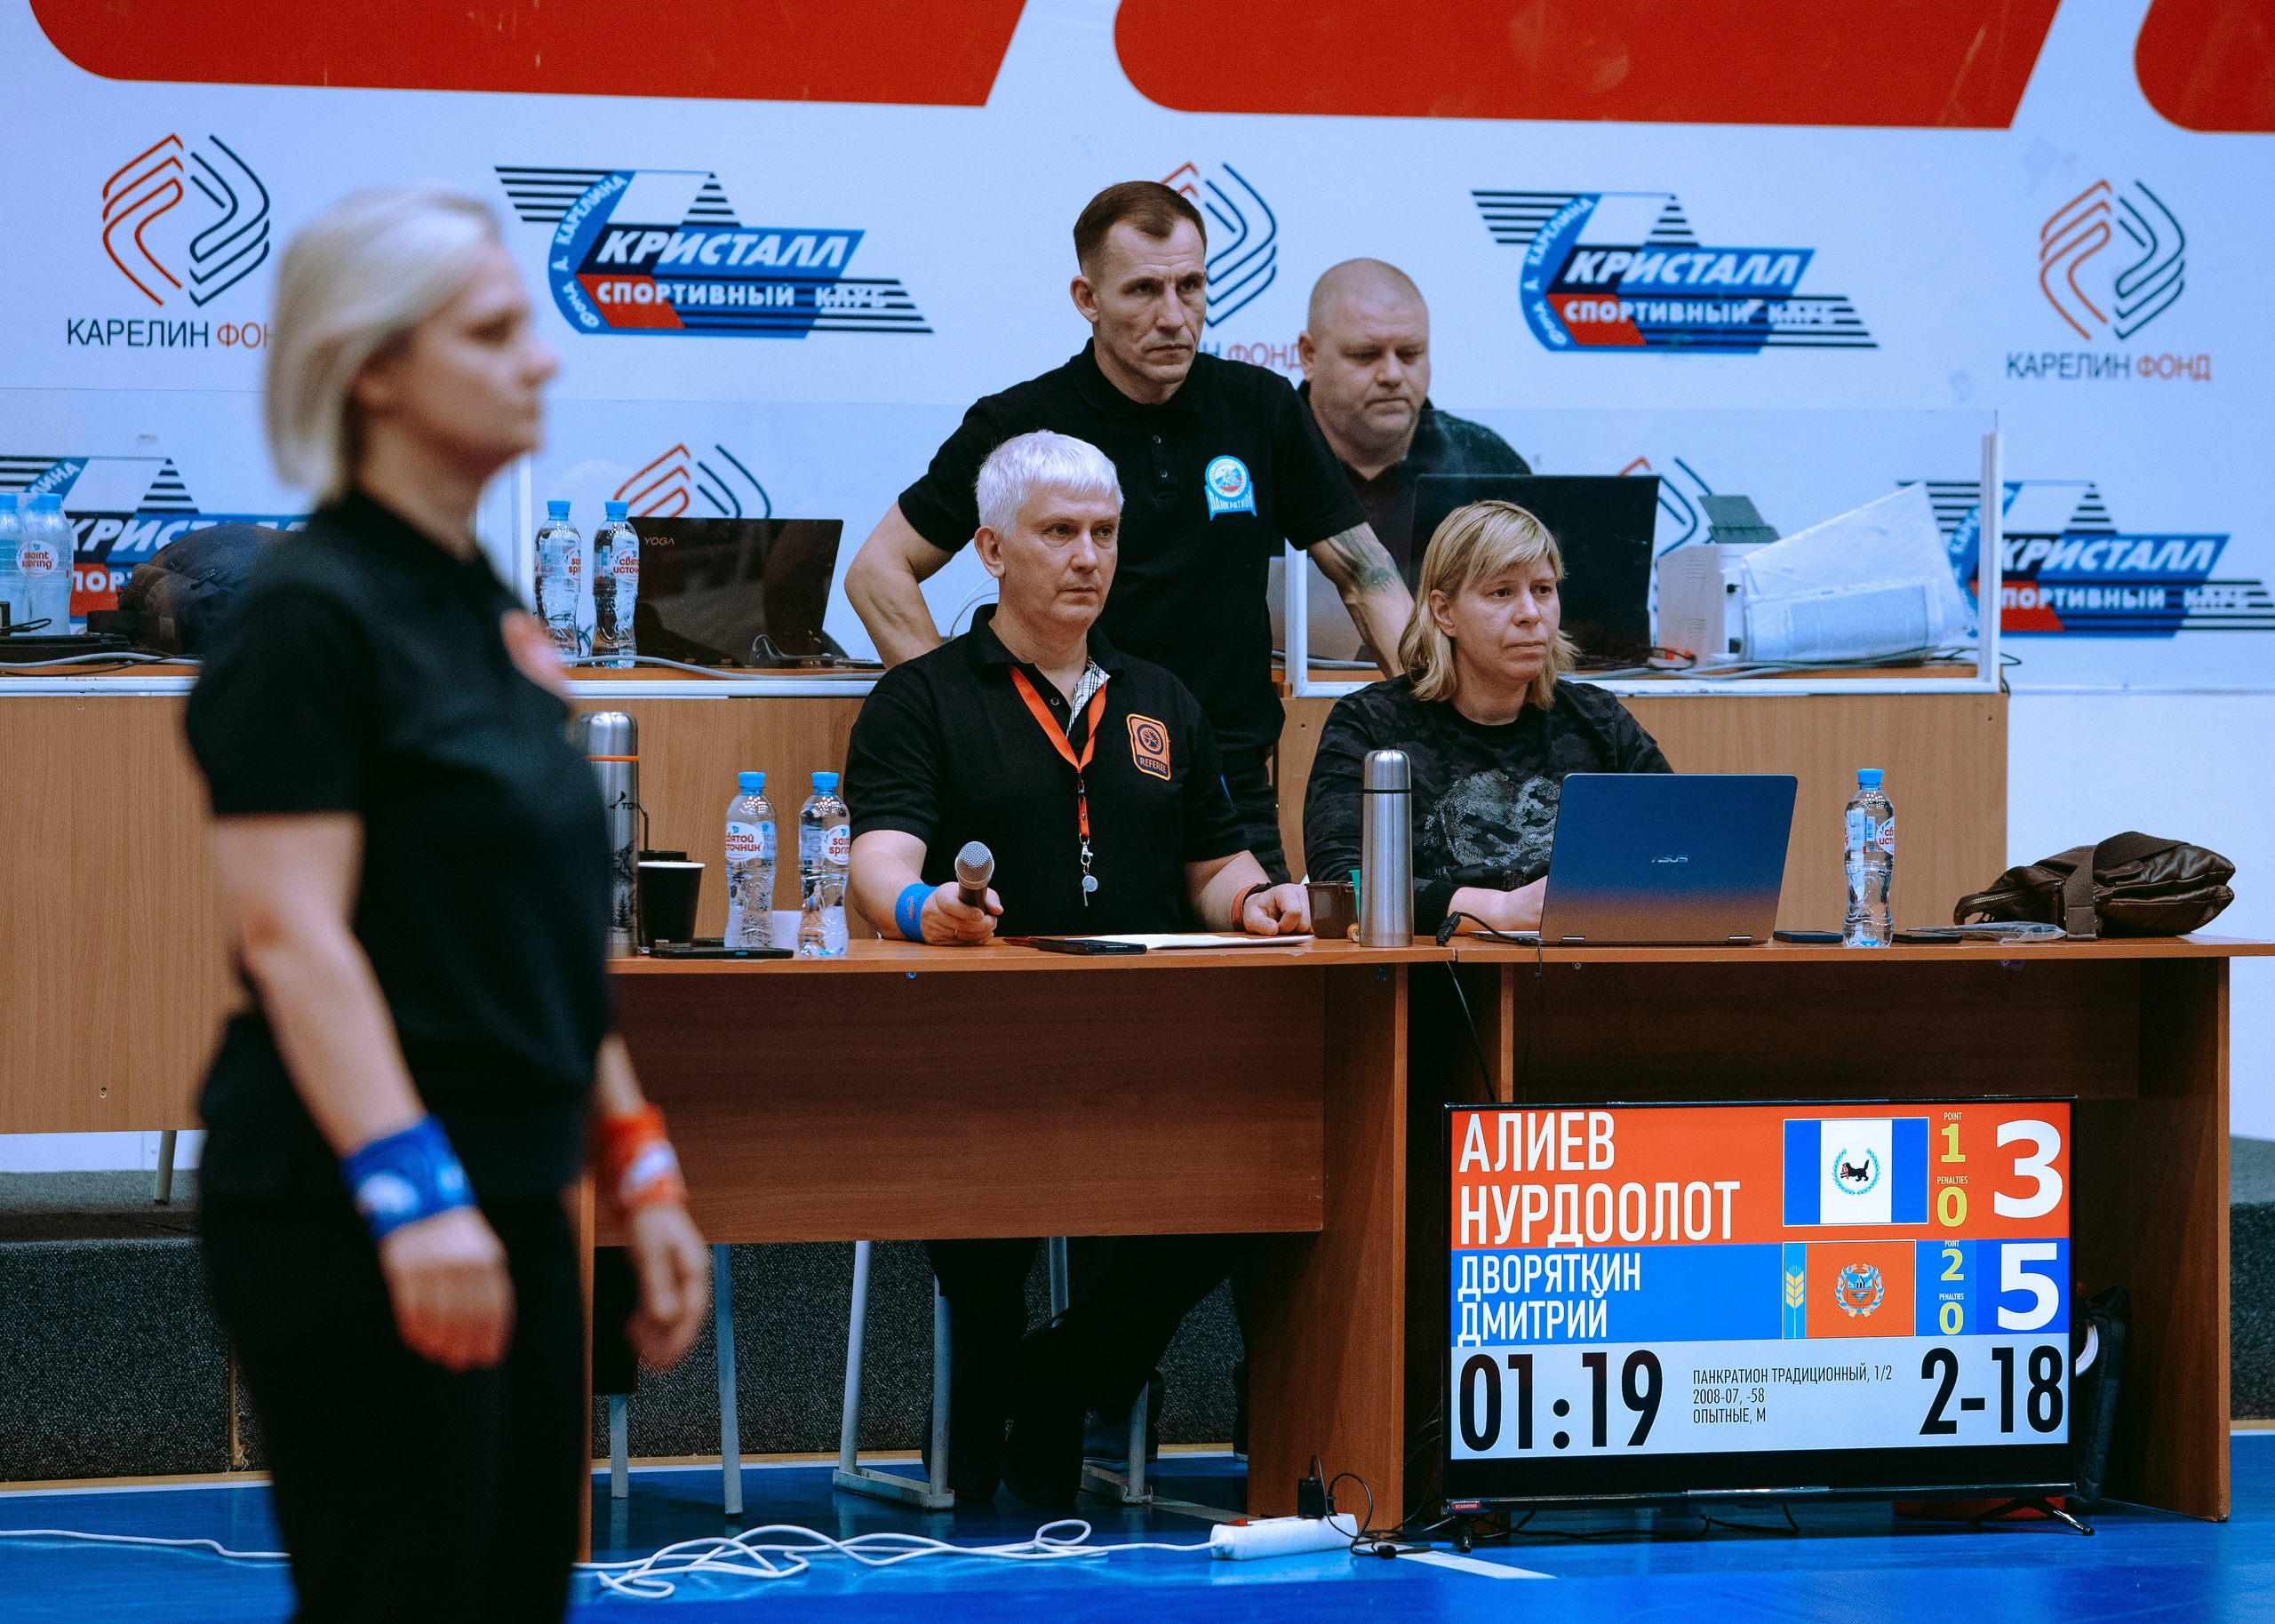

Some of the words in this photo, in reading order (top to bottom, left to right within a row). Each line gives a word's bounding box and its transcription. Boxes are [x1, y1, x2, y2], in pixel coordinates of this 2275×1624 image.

[555, 174, 629, 245] КАРЕЛИНА
[595, 230, 849, 267] КРИСТАЛЛ
[1563, 250, 1801, 285] КРИСТАЛЛ
[597, 282, 795, 307] СПОРТИВНЫЙ
[815, 283, 889, 308] КЛУБ
[1563, 300, 1752, 323] СПОРТИВНЫЙ
[68, 319, 210, 348] КАРЕЛИН
[2006, 352, 2131, 380] КАРЕЛИН
[2136, 354, 2212, 382] ФОНД
[1207, 485, 1253, 512] ПАНКРАТИОН
[644, 537, 675, 546] YOGA
[2000, 538, 2217, 571] КРИСТАЛЛ
[2001, 586, 2167, 609] ПОРТИВНЫЙ
[1139, 757, 1167, 773] REFEREE
[1944, 1112, 1962, 1121] POINT
[1458, 1111, 1615, 1173] АЛИЕВ
[1941, 1123, 1966, 1163] 1
[1936, 1175, 1968, 1185] PENALTIES
[1993, 1119, 2063, 1219] 3
[1461, 1181, 1741, 1248] НУРДООЛОТ
[1936, 1186, 1968, 1228] 0
[1457, 1253, 1640, 1302] ДВОРЯТКИН
[1941, 1248, 1964, 1281] 2
[1998, 1242, 2059, 1331] 5
[1457, 1289, 1608, 1348] ДМИТРИЙ
[1939, 1302, 1964, 1335] 0
[1693, 1368, 1768, 1385] ПАНКРАТИОН
[1771, 1362, 1870, 1385] ТРАДИЦИОННЫЙ,
[1874, 1365, 1892, 1382] 1/2
[1459, 1349, 1664, 1452] 01:19
[1693, 1388, 1743, 1405] 2008-07,
[1746, 1387, 1765, 1403] -58
[1919, 1345, 2063, 1436] 2-18
[1693, 1407, 1752, 1425] ОПЫТНЫЕ,
[1756, 1407, 1766, 1422] М
